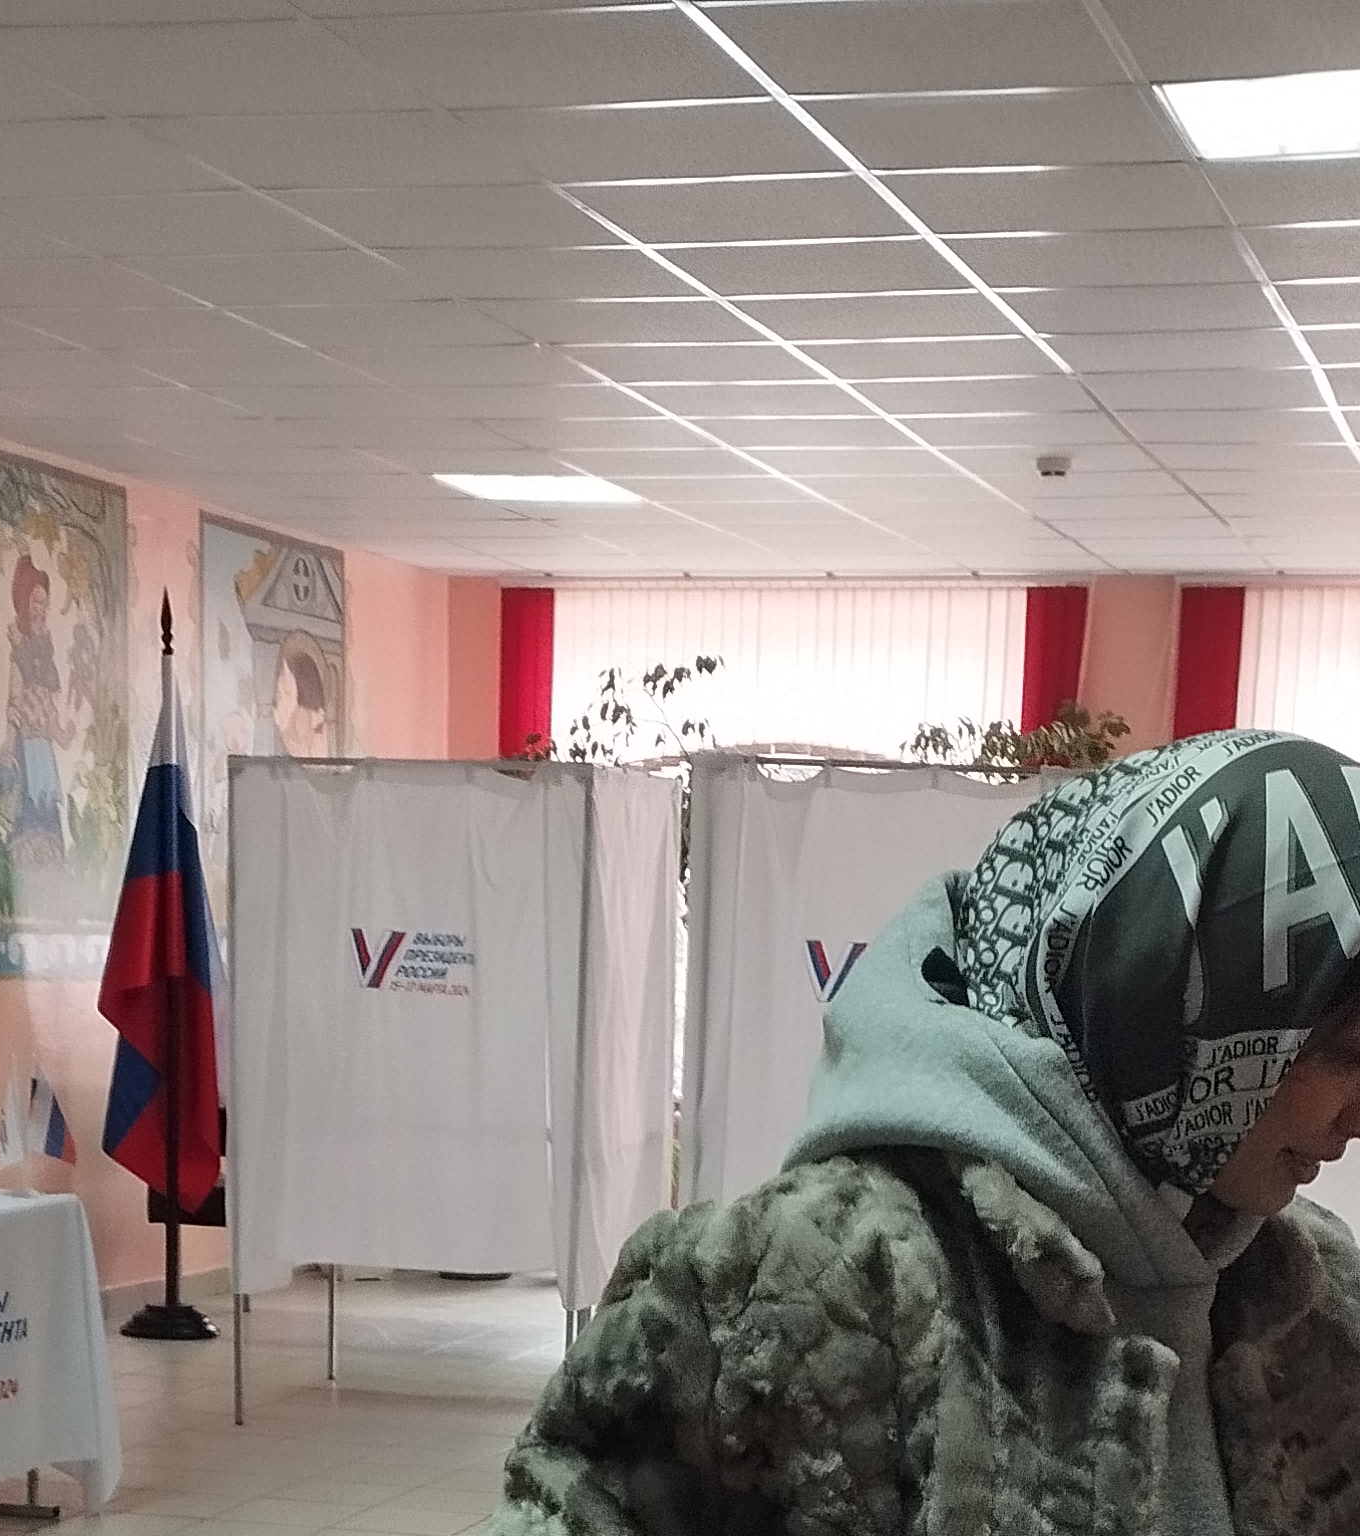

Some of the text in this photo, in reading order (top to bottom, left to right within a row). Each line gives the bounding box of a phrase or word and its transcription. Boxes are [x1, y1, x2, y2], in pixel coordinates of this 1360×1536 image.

[1144, 765, 1203, 828] J'ADIOR
[1203, 1036, 1279, 1072] J'ADIOR
[1174, 1101, 1233, 1140] J'ADIOR
